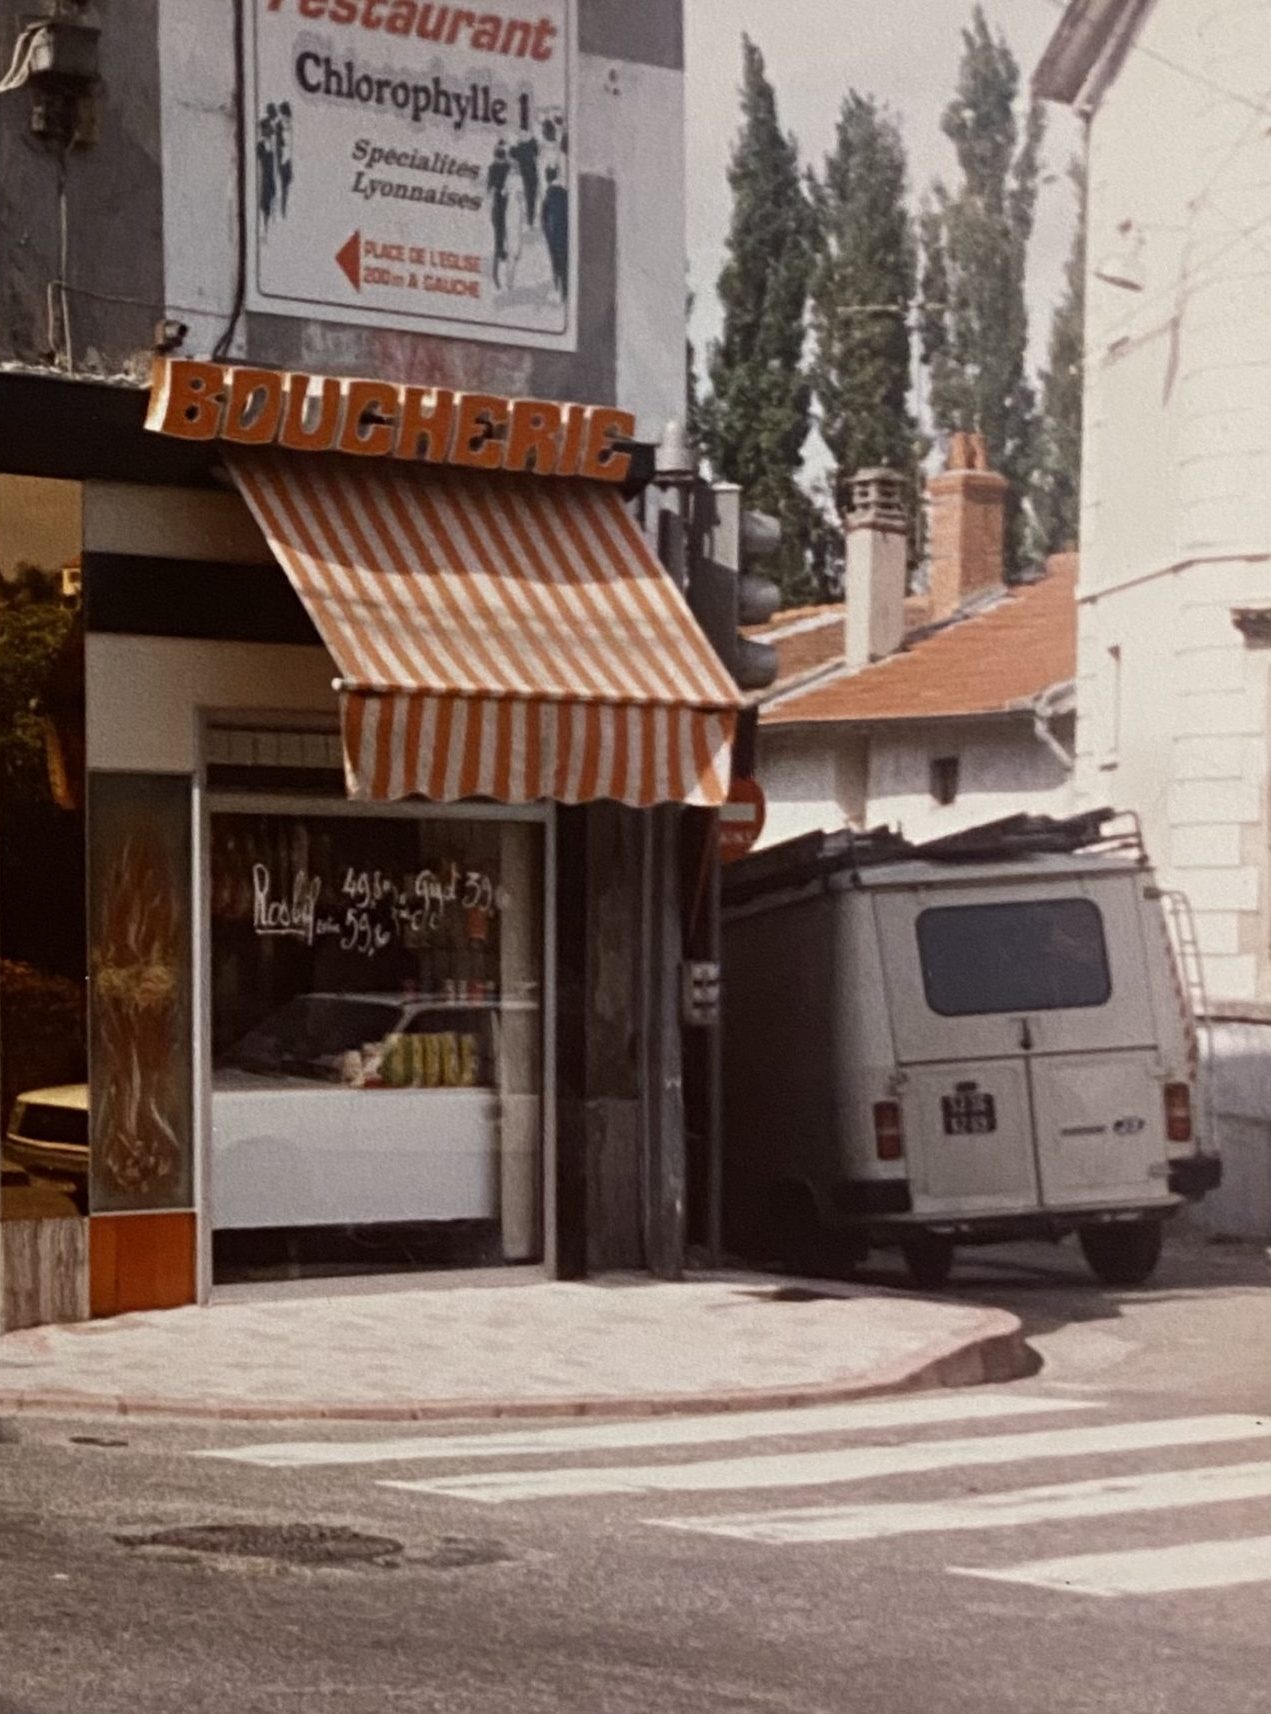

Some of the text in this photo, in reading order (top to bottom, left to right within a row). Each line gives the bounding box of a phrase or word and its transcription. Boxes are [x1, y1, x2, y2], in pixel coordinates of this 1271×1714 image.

[295, 51, 507, 130] Chlorophylle
[352, 171, 483, 212] Lyonnaises
[365, 240, 405, 262] PLACE
[409, 246, 425, 265] DE
[423, 274, 481, 299] GAUCHE
[150, 357, 636, 483] BOUCHERIE
